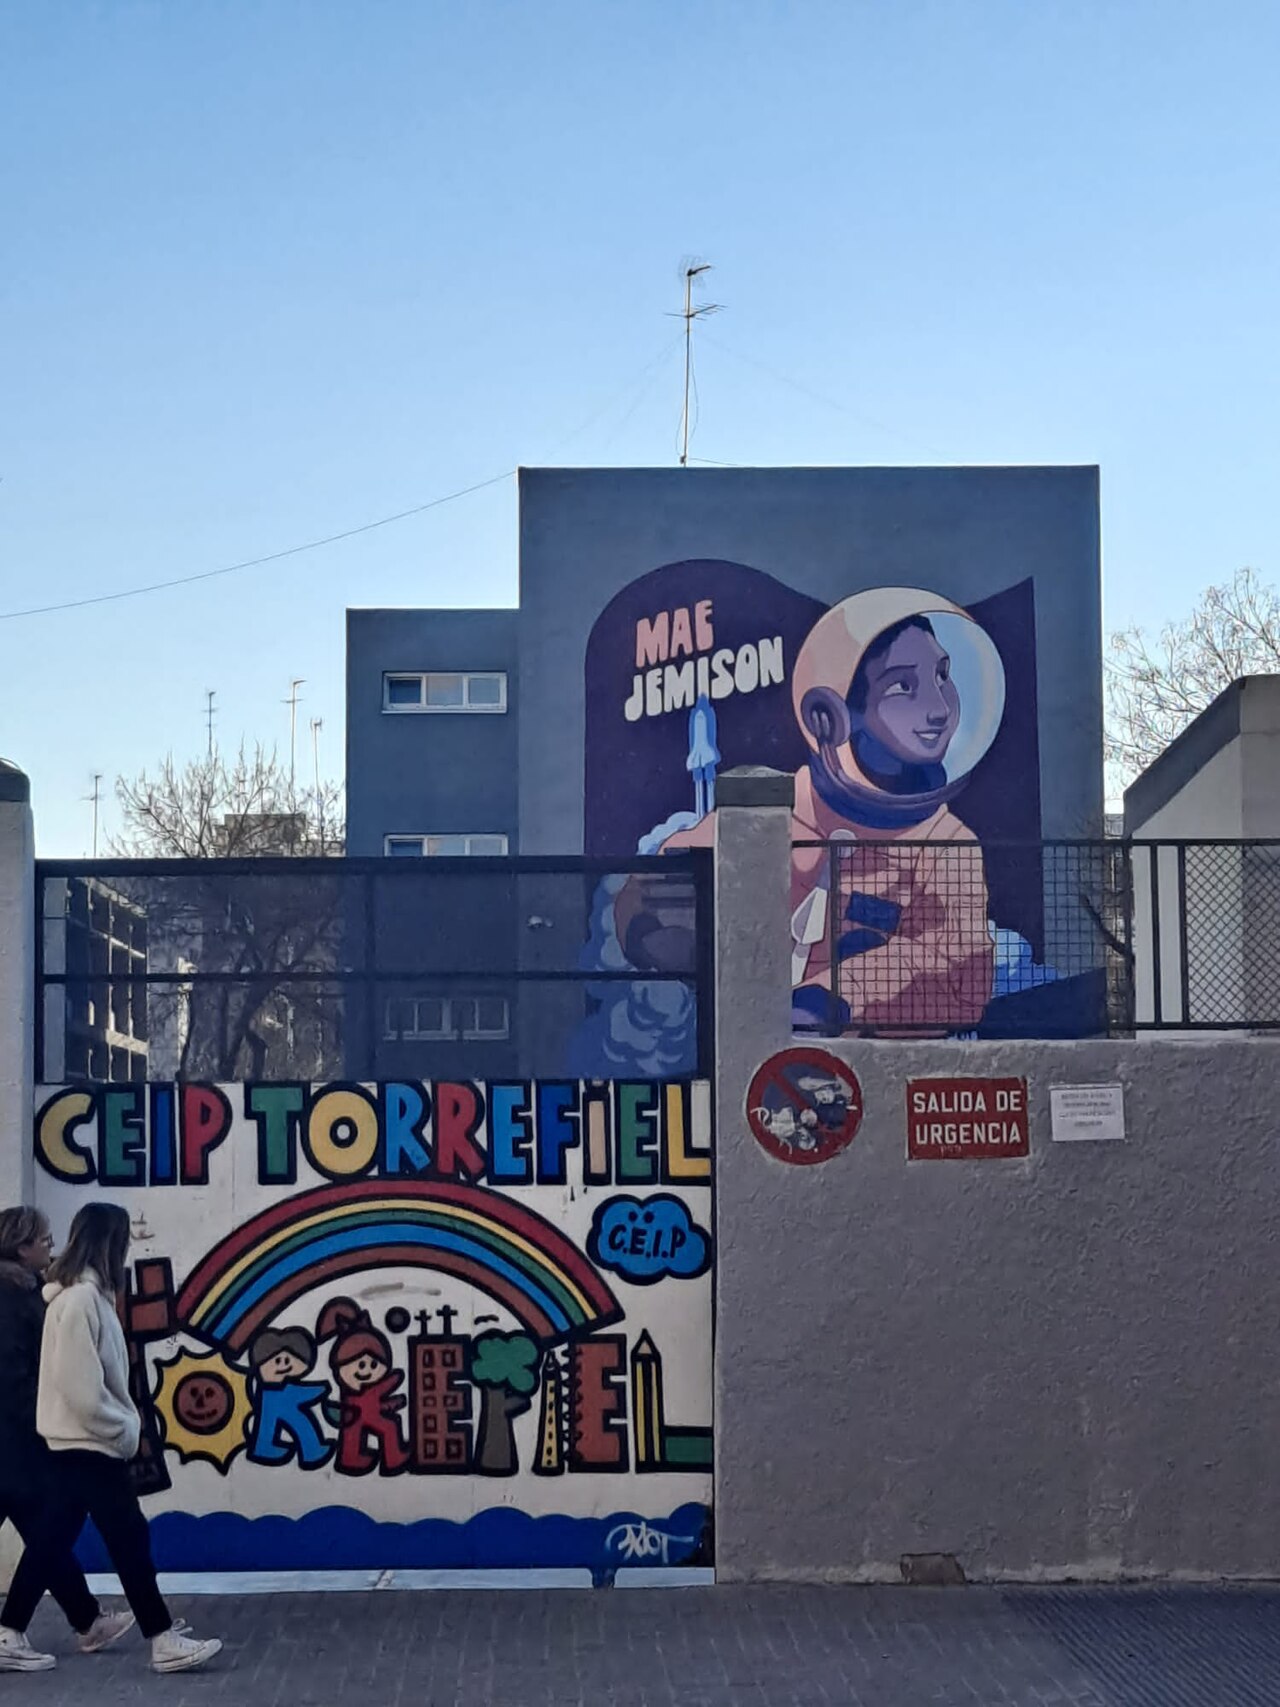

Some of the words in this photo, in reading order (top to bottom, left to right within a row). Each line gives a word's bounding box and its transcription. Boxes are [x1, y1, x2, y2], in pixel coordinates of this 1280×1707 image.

[635, 599, 714, 669] MAE
[624, 636, 785, 722] JEMISON
[34, 1081, 233, 1187] CEIP
[913, 1091, 987, 1113] SALIDA
[996, 1090, 1023, 1112] DE
[915, 1122, 1021, 1145] URGENCIA
